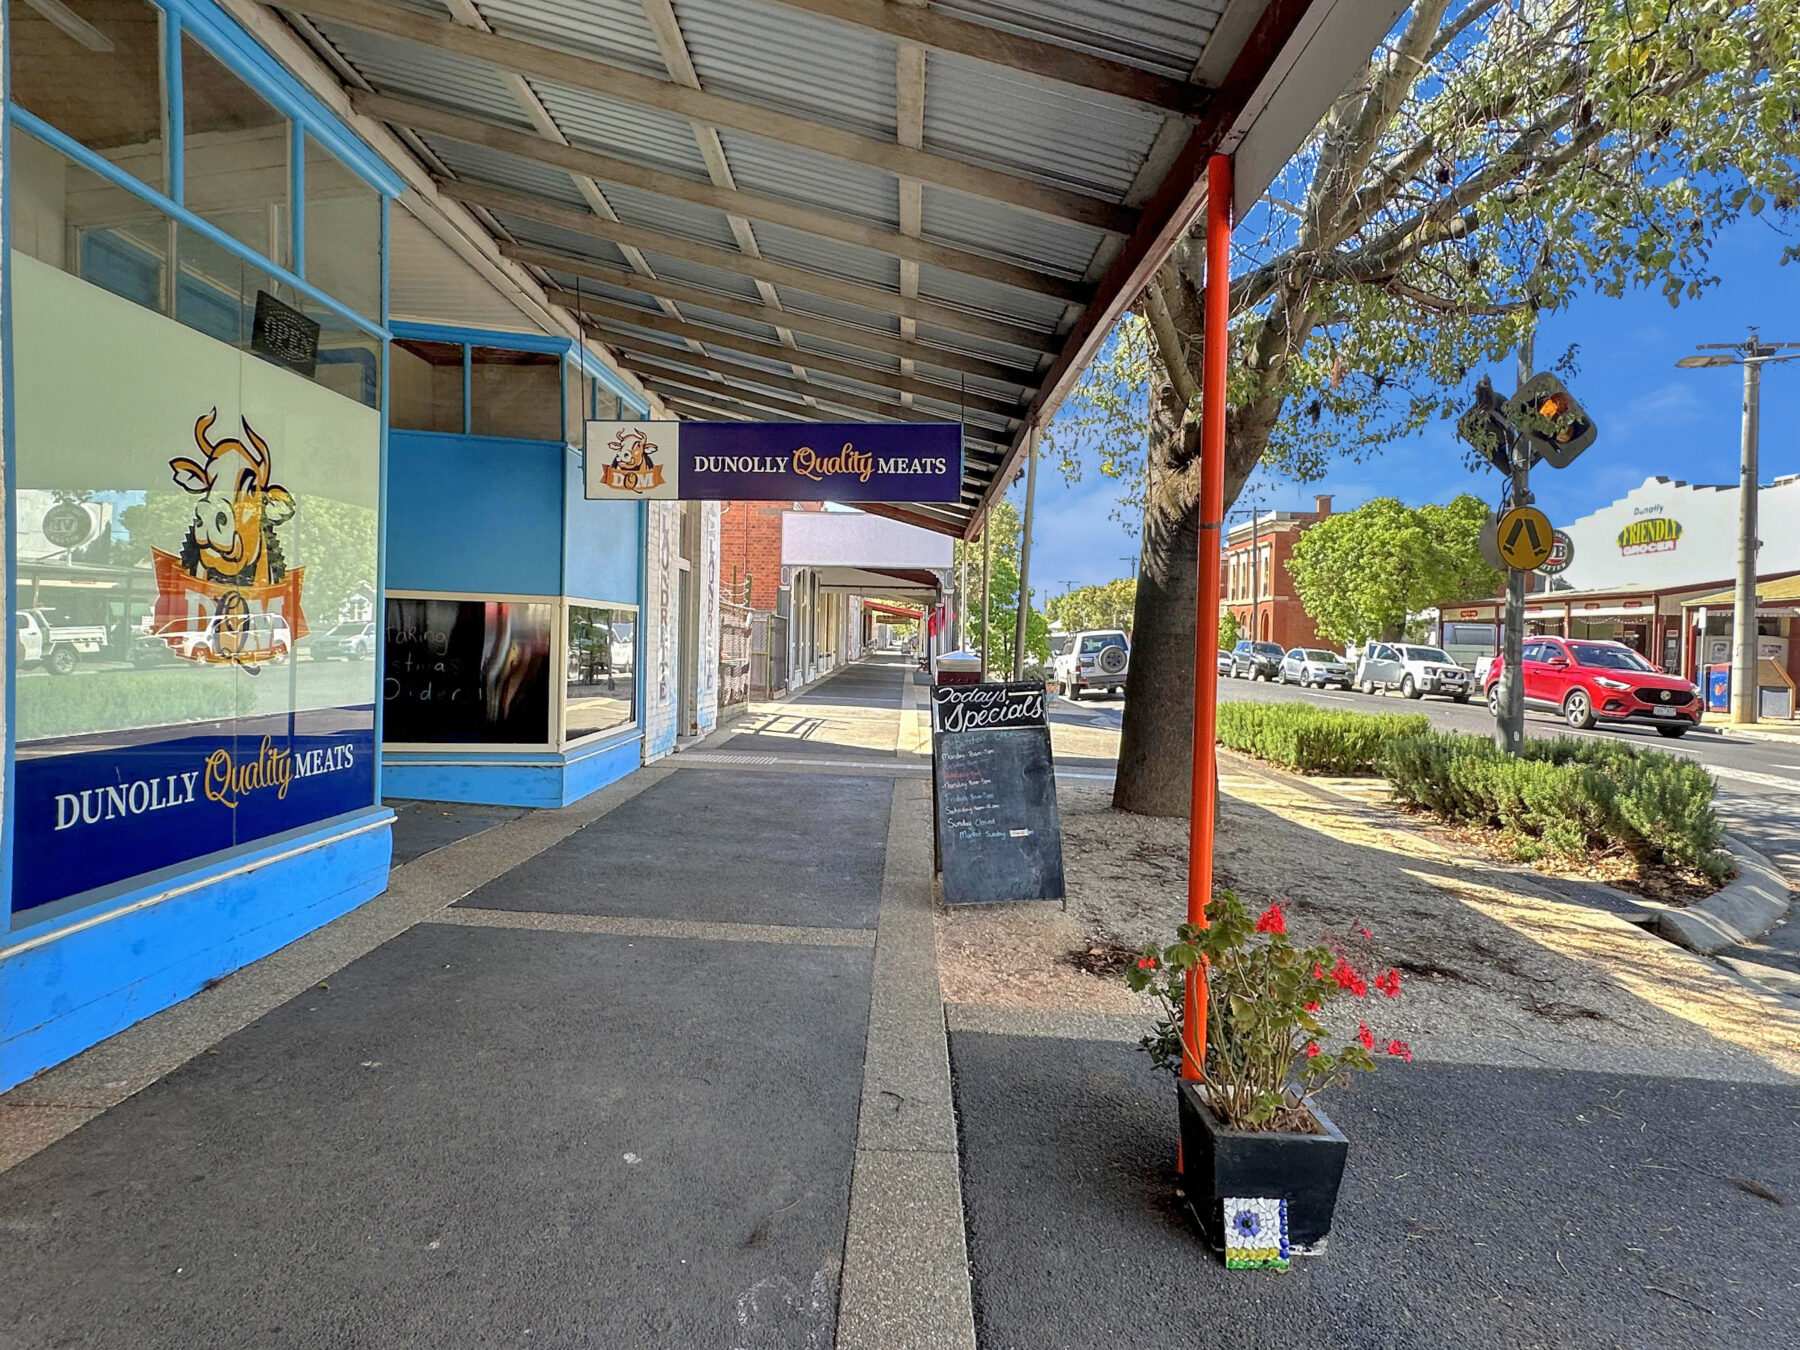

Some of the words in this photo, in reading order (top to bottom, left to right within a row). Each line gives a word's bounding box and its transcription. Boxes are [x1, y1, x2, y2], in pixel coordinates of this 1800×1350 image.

[693, 455, 789, 473] DUNOLLY
[792, 442, 875, 483] Quality
[877, 457, 947, 475] MEATS
[1633, 503, 1664, 516] Dunolly
[1622, 517, 1678, 546] FRIENDLY
[933, 687, 1007, 708] Todays
[944, 695, 1044, 733] Specials
[54, 771, 199, 831] DUNOLLY
[204, 735, 294, 809] Quality
[294, 743, 355, 779] MEATS
